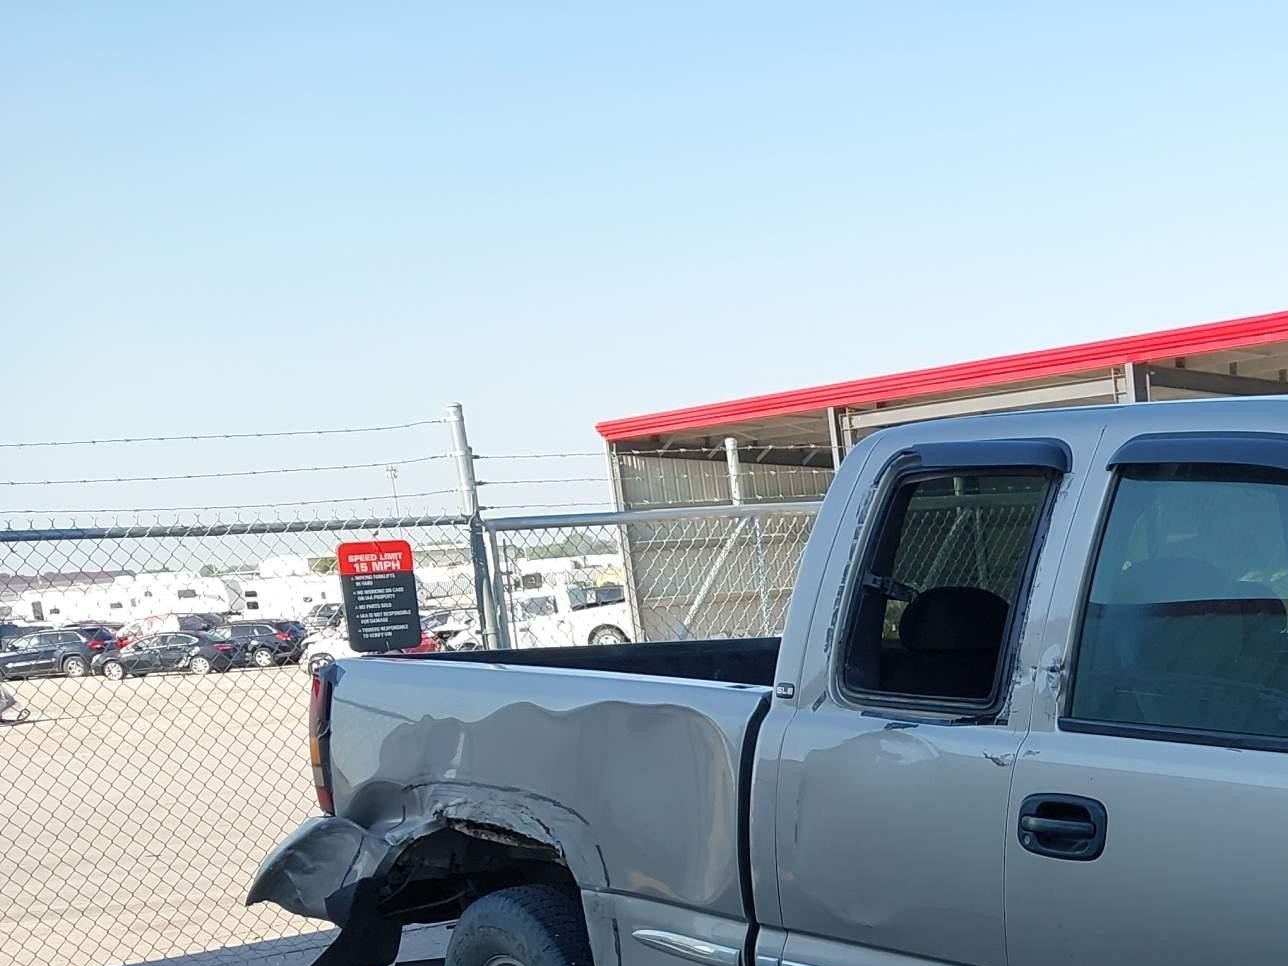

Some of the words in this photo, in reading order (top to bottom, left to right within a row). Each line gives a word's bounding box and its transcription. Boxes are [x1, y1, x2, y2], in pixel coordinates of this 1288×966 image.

[348, 553, 378, 563] SPEED
[379, 552, 402, 561] LIMIT
[353, 563, 368, 572] 15
[371, 560, 401, 572] MPH
